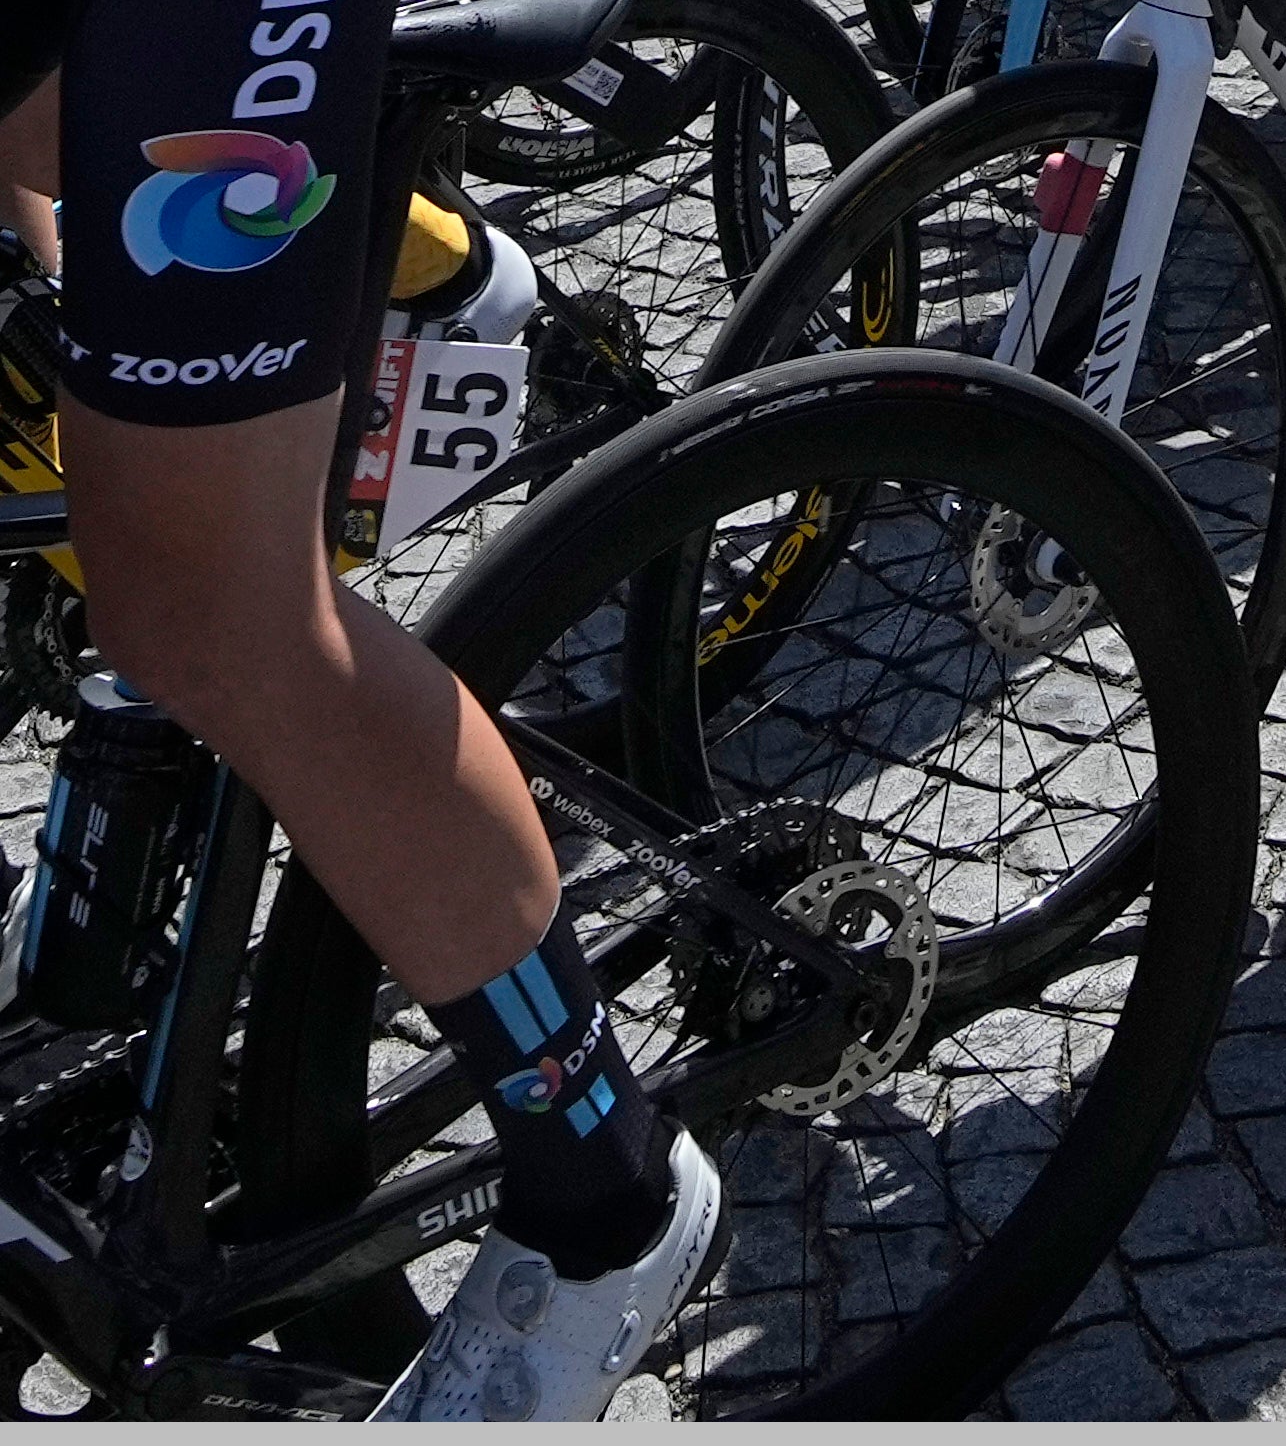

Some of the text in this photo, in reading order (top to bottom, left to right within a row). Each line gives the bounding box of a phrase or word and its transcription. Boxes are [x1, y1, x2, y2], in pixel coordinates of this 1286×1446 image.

[108, 337, 309, 387] zoover
[410, 371, 509, 473] 55
[553, 793, 615, 839] webex
[624, 838, 702, 890] zoover
[563, 1000, 606, 1076] DSM
